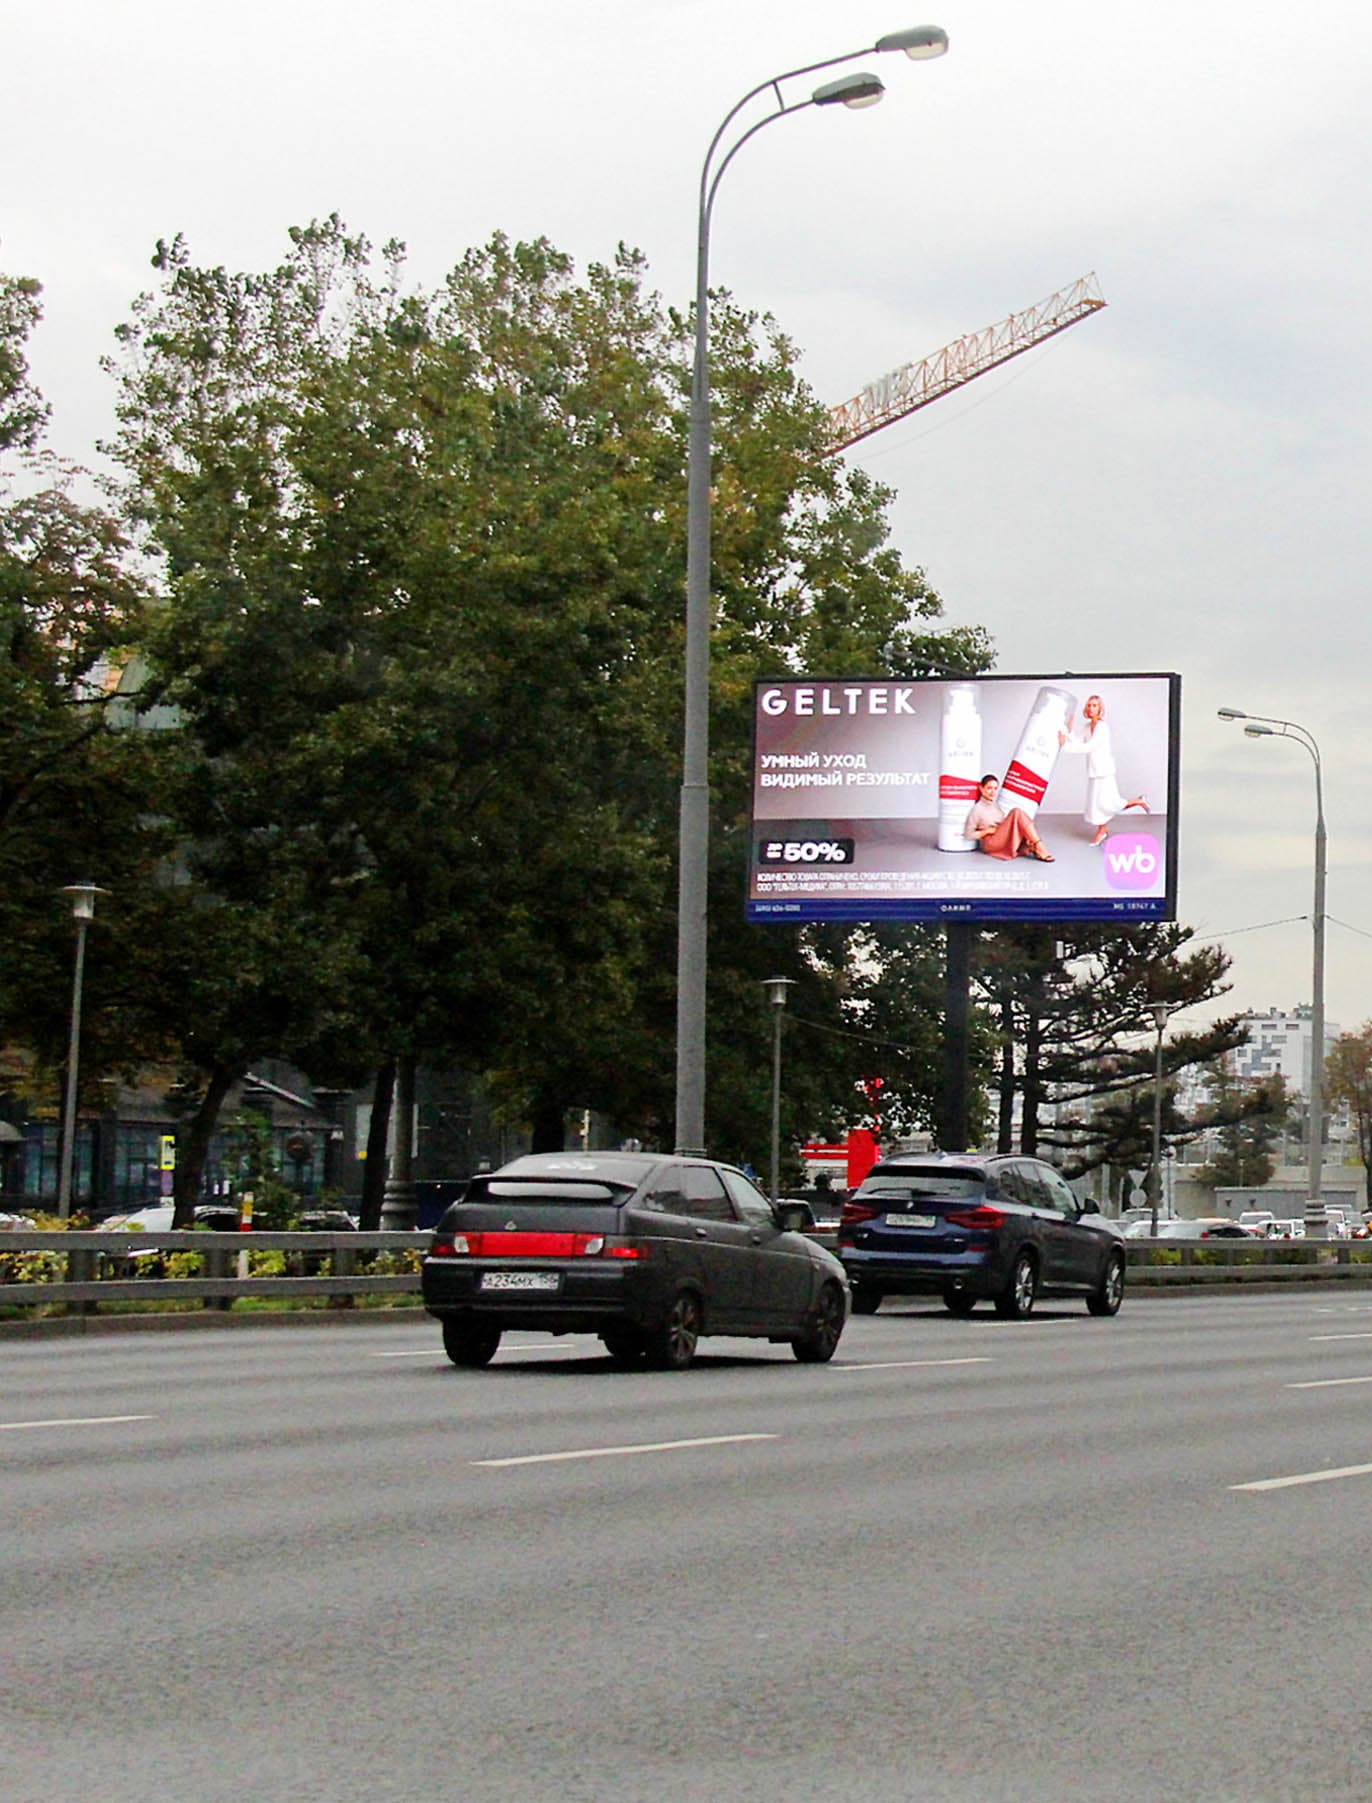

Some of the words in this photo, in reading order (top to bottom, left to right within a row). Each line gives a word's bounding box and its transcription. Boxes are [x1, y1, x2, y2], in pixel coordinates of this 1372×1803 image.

[761, 688, 916, 716] GELTEK
[761, 752, 820, 769] УМНЫЙ
[823, 754, 867, 769] УХОД
[760, 771, 843, 788] ВИДИМЫЙ
[846, 772, 930, 786] РЕЗУЛЬТАТ
[1108, 845, 1157, 874] wb
